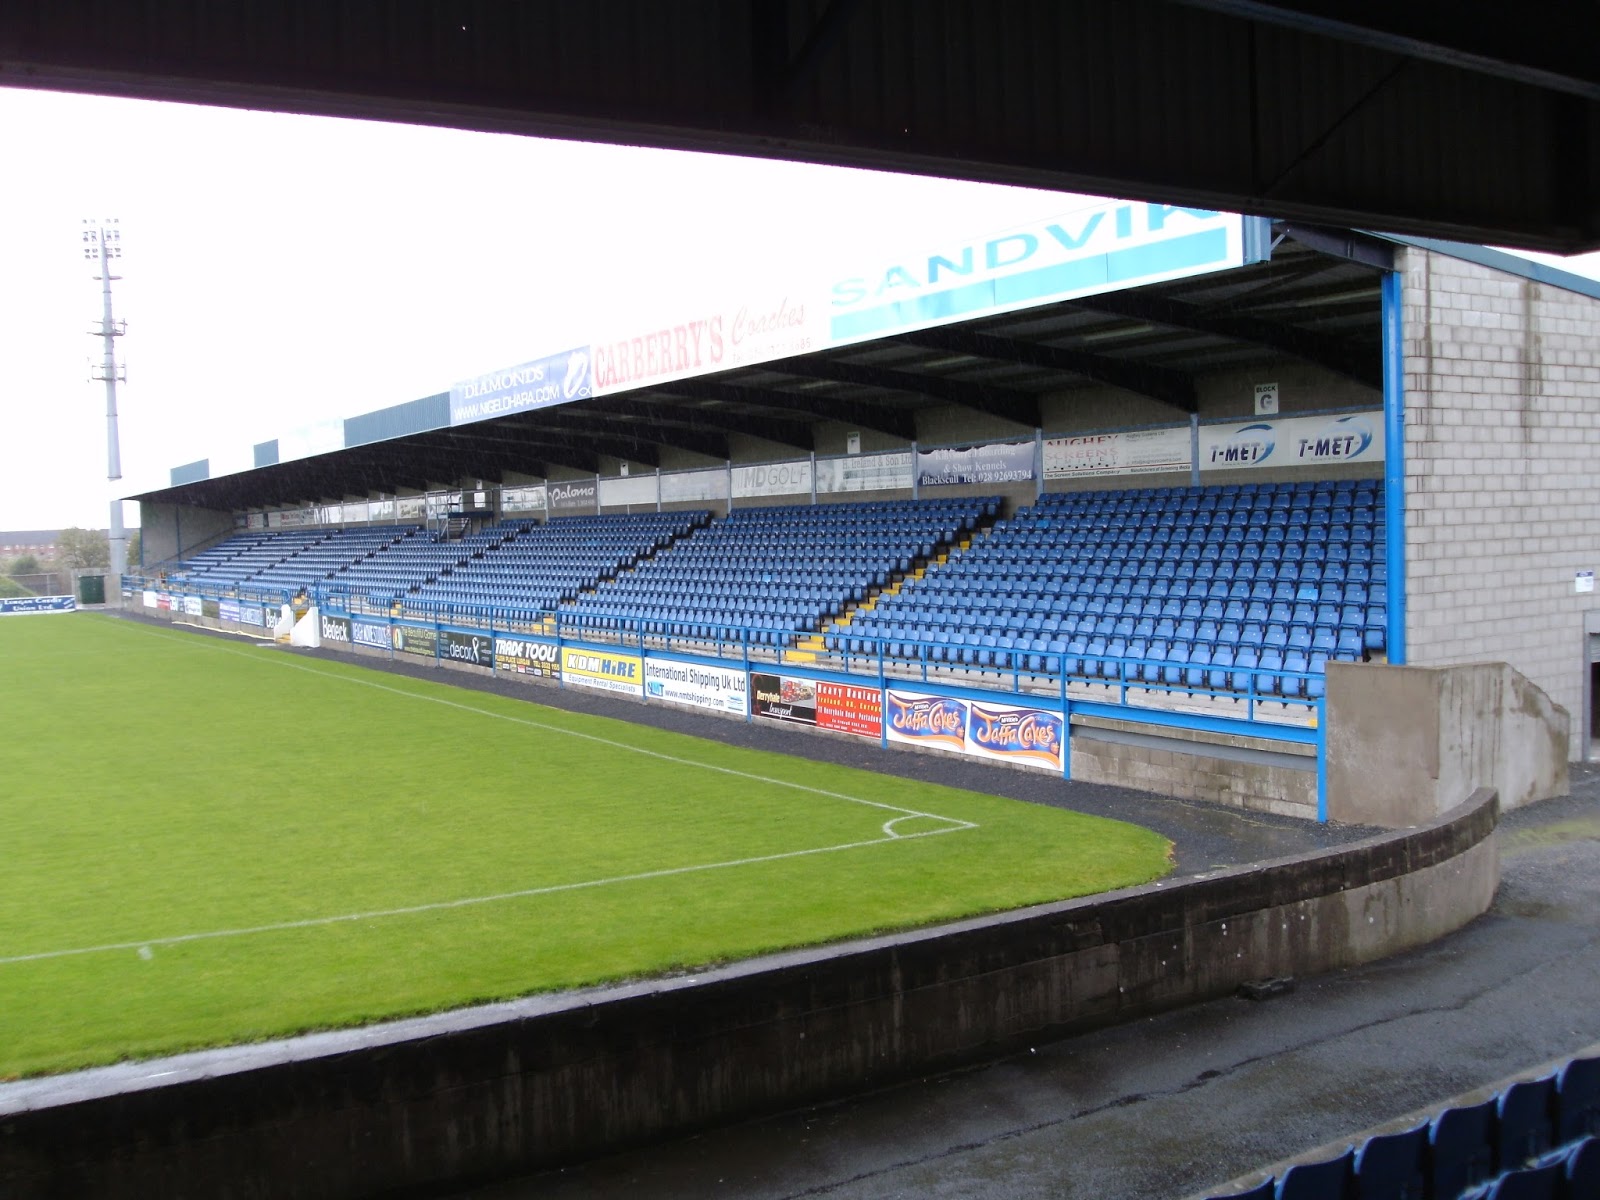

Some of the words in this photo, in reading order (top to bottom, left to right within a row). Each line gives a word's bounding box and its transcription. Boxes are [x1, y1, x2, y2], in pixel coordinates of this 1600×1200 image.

[595, 315, 724, 389] CARBERRY'S
[731, 297, 805, 347] Coaches
[464, 365, 544, 398] DIAMONDS
[1255, 384, 1276, 393] BLOCK
[454, 385, 560, 420] WWW.NIGELOHARA.COM
[1045, 447, 1119, 459] SCREENS
[1210, 442, 1260, 462] T-MET
[1299, 435, 1355, 458] T-MET
[852, 457, 876, 469] Ireland
[886, 456, 898, 466] Son
[943, 465, 951, 473] &
[952, 463, 972, 473] Show
[975, 461, 1007, 471] Kennels
[922, 474, 959, 486] Blackscull
[962, 473, 976, 483] Tel:
[978, 471, 993, 482] 028
[994, 470, 1032, 480] 92693794
[495, 639, 524, 657] TRADE
[525, 643, 557, 662] TOOLS
[567, 653, 600, 673] KDM
[568, 674, 593, 685] Equipment
[593, 678, 608, 687] Rental
[609, 681, 636, 693] Specialists
[645, 662, 688, 682] International
[689, 668, 719, 691] Shipping
[721, 674, 731, 690] Uk
[733, 676, 746, 692] Ltd
[665, 689, 724, 707] www.nmtshipping.com
[817, 683, 842, 698] Heavy
[846, 688, 881, 703] Haulage
[860, 702, 881, 712] Europe
[889, 695, 928, 731] Jaffa
[929, 703, 961, 733] Cakes
[972, 707, 1017, 745] Jaffa
[1018, 715, 1055, 748] Cakes
